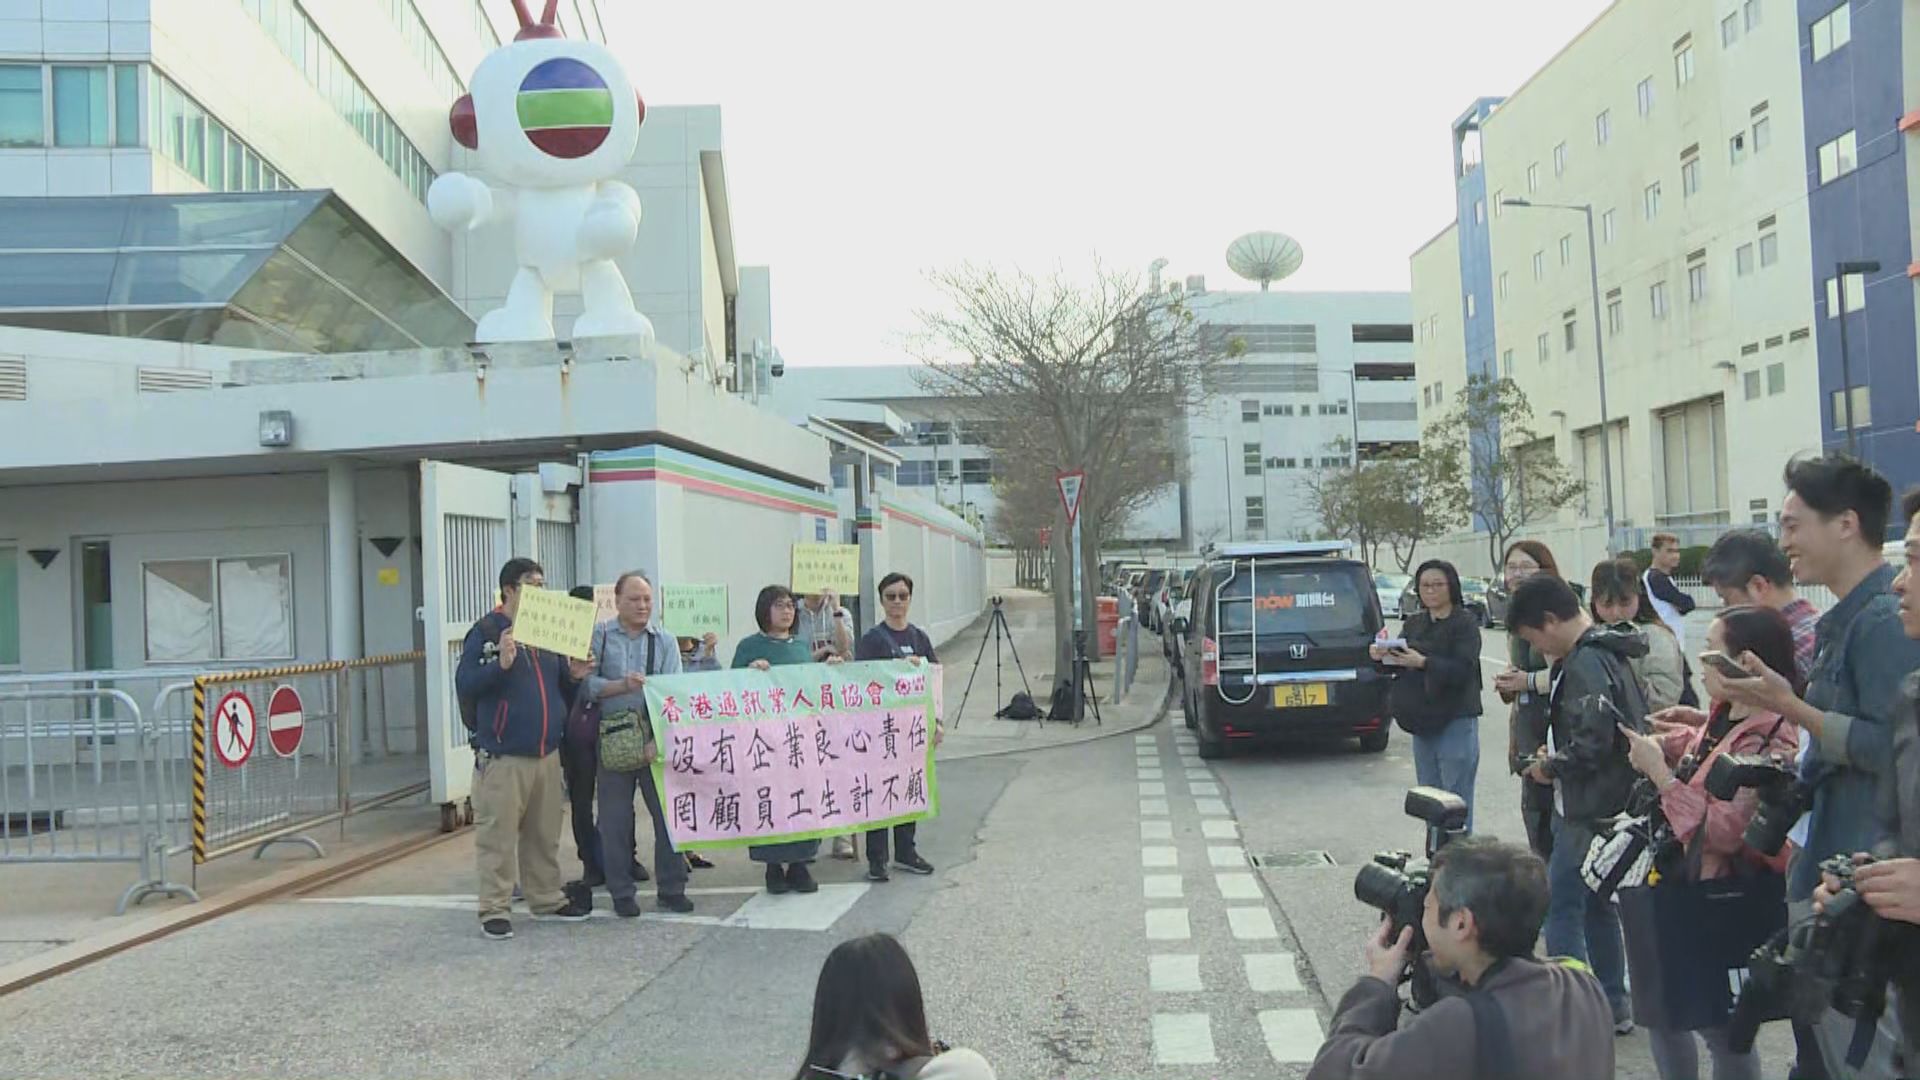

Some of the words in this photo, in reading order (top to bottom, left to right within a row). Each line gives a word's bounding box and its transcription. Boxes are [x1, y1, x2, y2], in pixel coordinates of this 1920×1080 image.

[1256, 594, 1293, 609] now
[661, 680, 885, 722] 香港通訊業人員協會
[673, 767, 926, 832] 罔顧員工生計不顧
